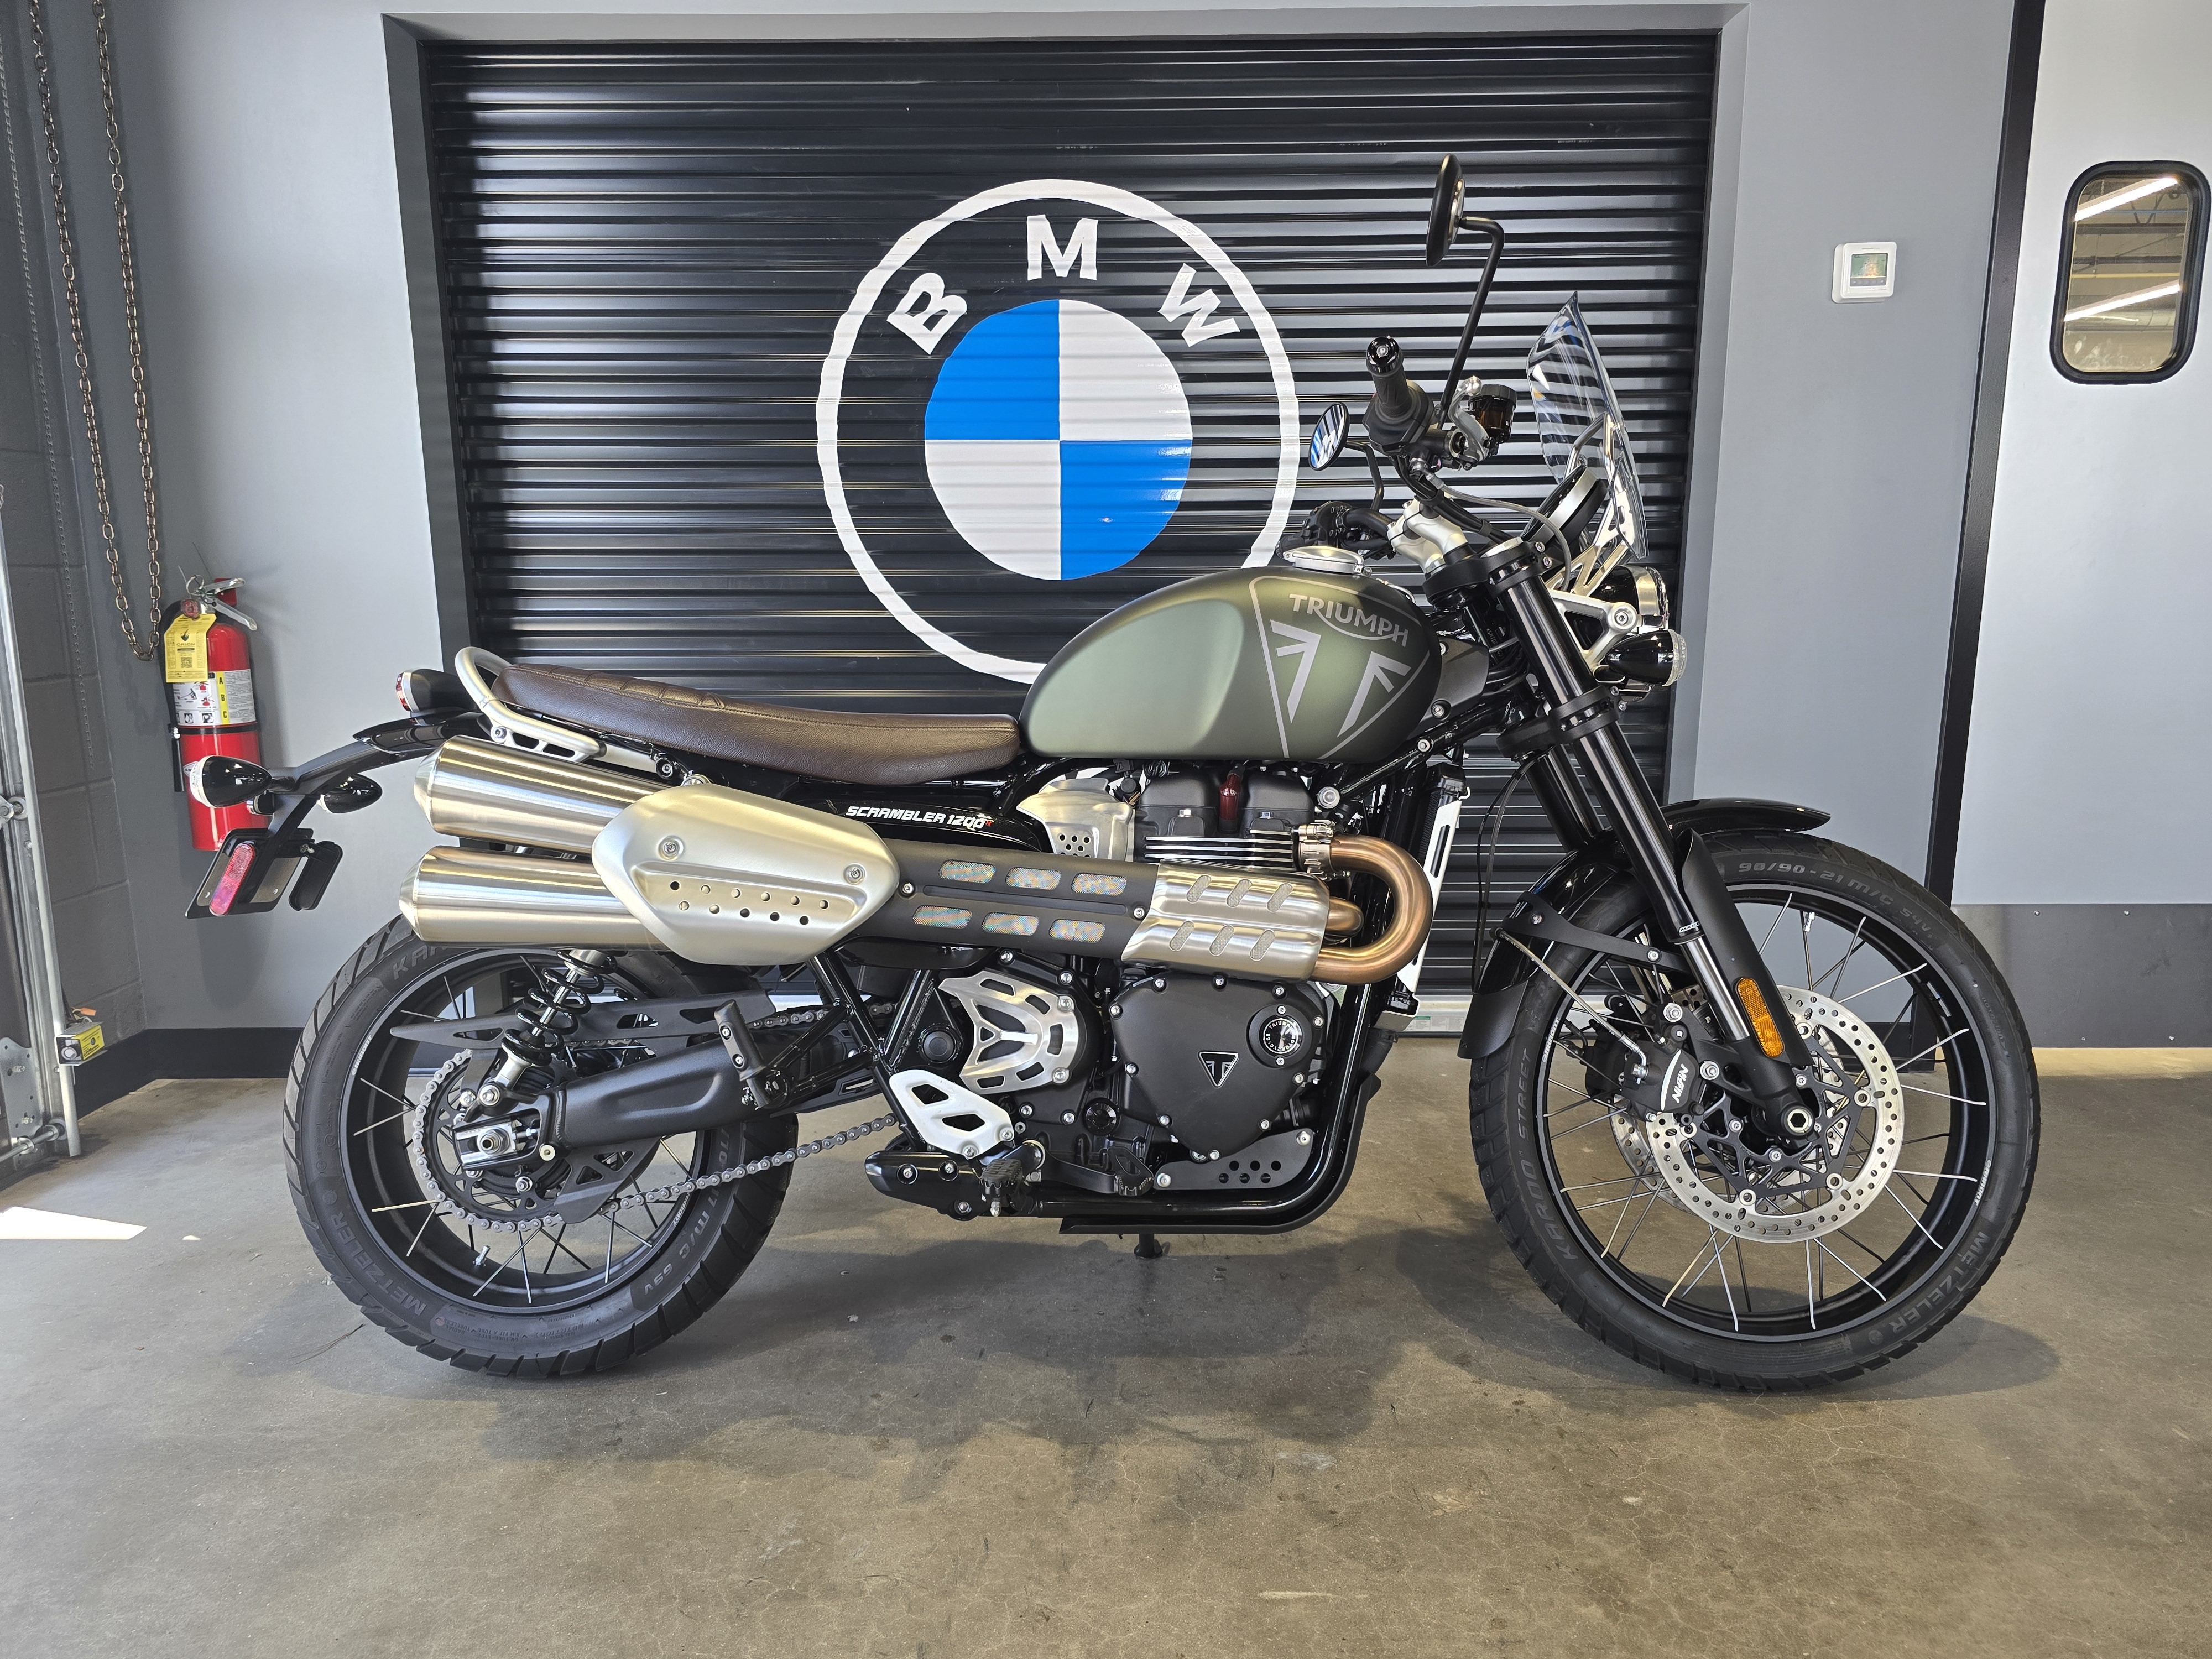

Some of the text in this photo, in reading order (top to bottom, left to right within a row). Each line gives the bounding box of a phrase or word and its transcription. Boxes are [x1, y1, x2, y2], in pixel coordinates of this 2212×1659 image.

[886, 214, 1240, 354] BMW
[1289, 594, 1408, 647] TRIUMPH
[845, 806, 985, 828] SCRAMBLER 1200
[1739, 862, 1806, 874] 90/90
[1819, 870, 1844, 883] 21
[1847, 879, 1894, 905] M/C
[1517, 1048, 1532, 1142] STREET
[1672, 1063, 1689, 1103] NISSIN
[679, 1211, 711, 1260] M/C
[331, 1211, 428, 1316] METZELER
[644, 1263, 673, 1295] 69V
[1888, 1231, 1991, 1334] METZELER
